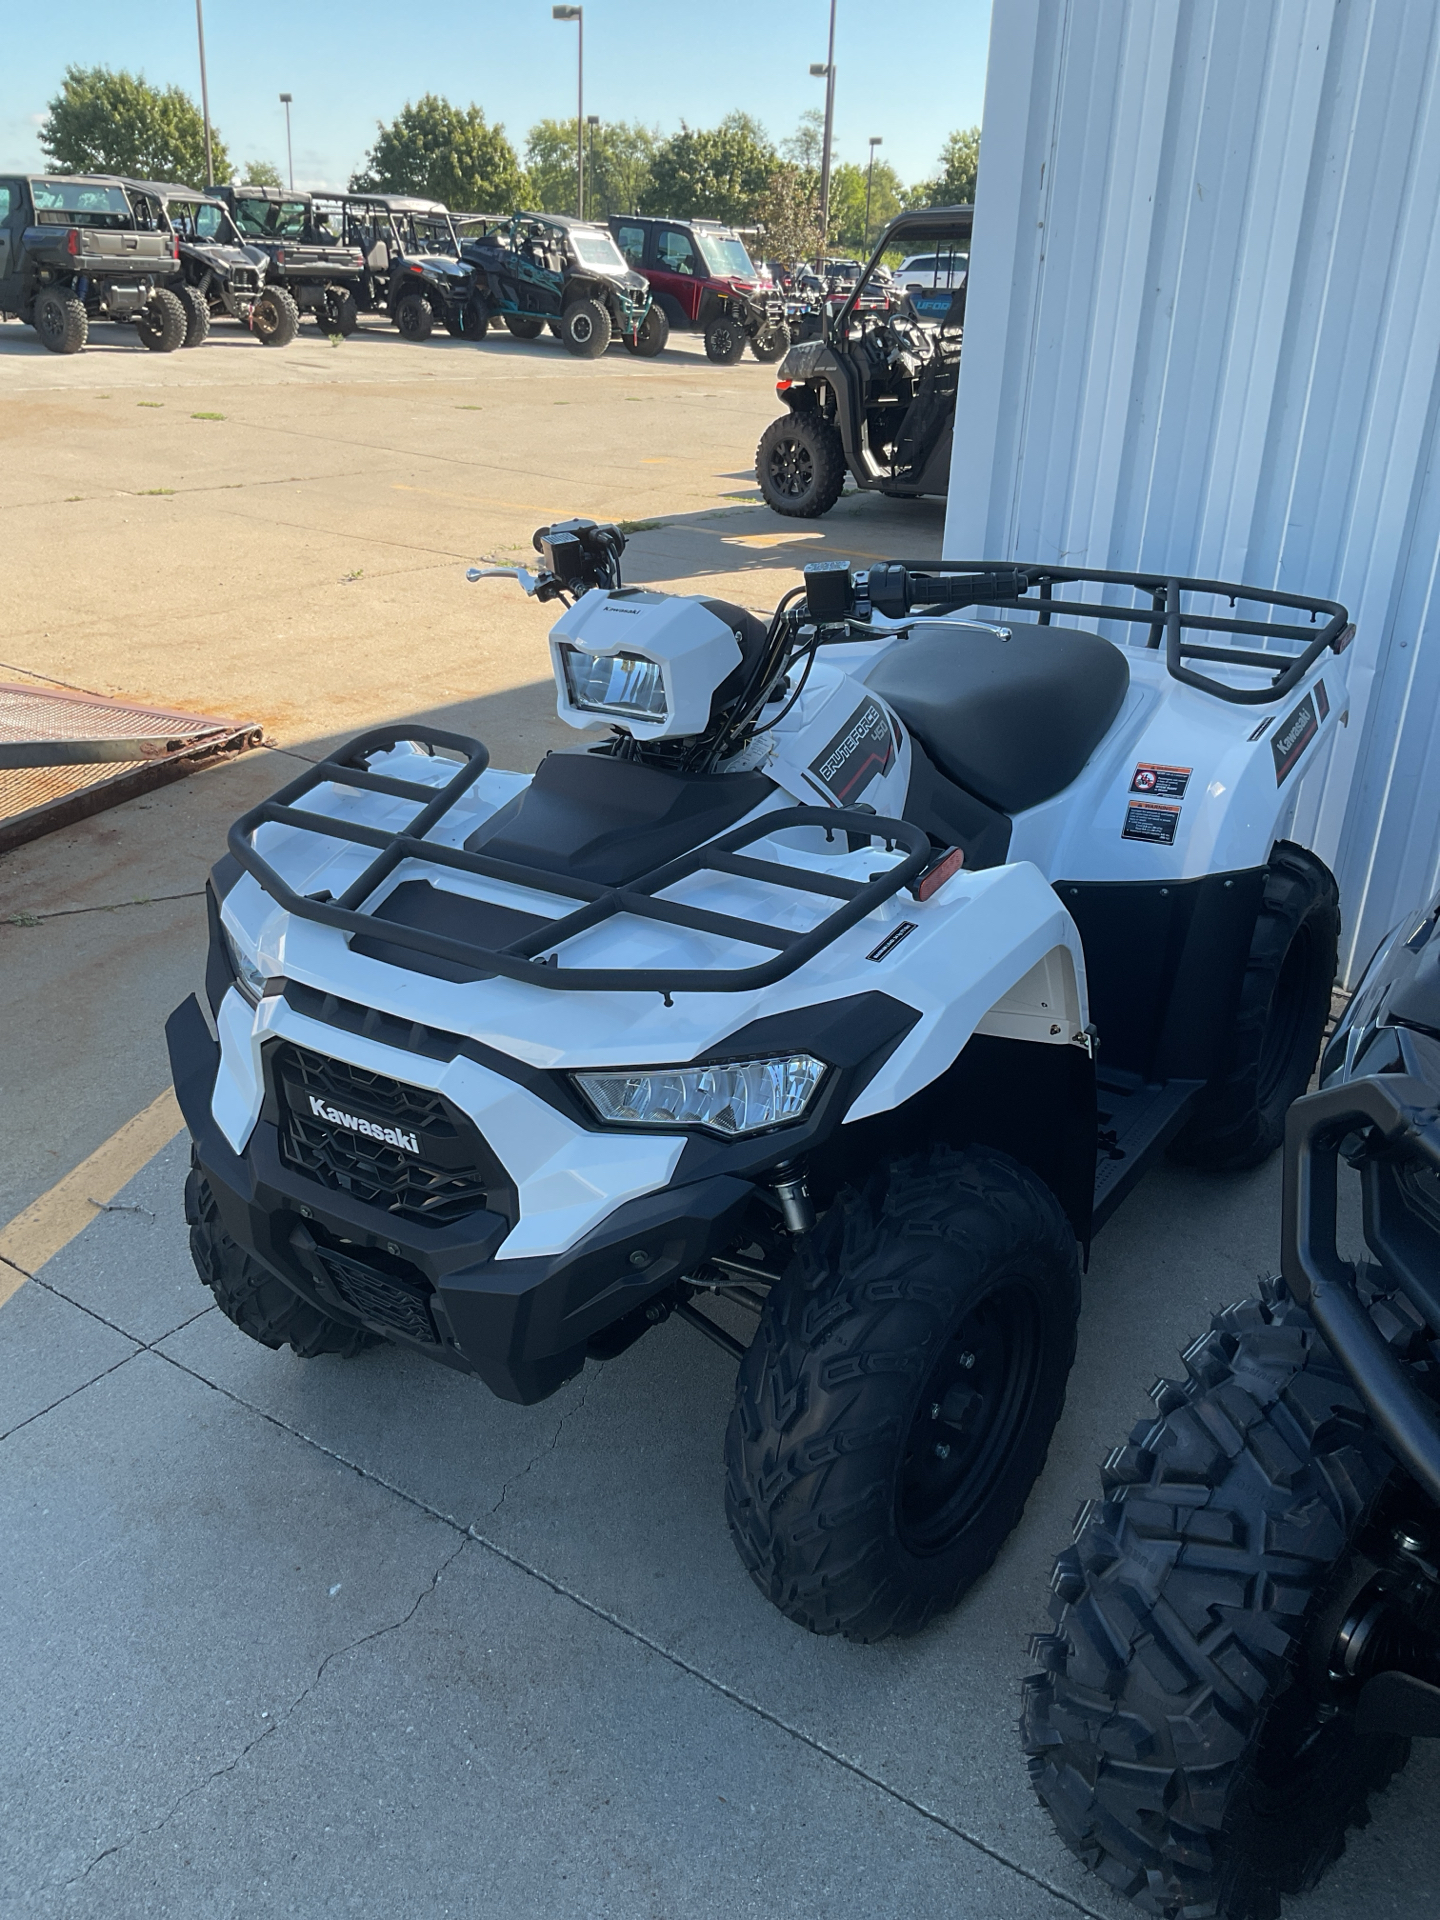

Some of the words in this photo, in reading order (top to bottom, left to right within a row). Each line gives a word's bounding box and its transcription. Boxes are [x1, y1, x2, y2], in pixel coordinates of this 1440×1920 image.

[602, 606, 641, 615] Kawasaki
[871, 720, 889, 741] 450
[1276, 707, 1311, 755] Kawasaki
[1144, 803, 1173, 811] WARNING
[309, 1095, 420, 1155] Kawasaki
